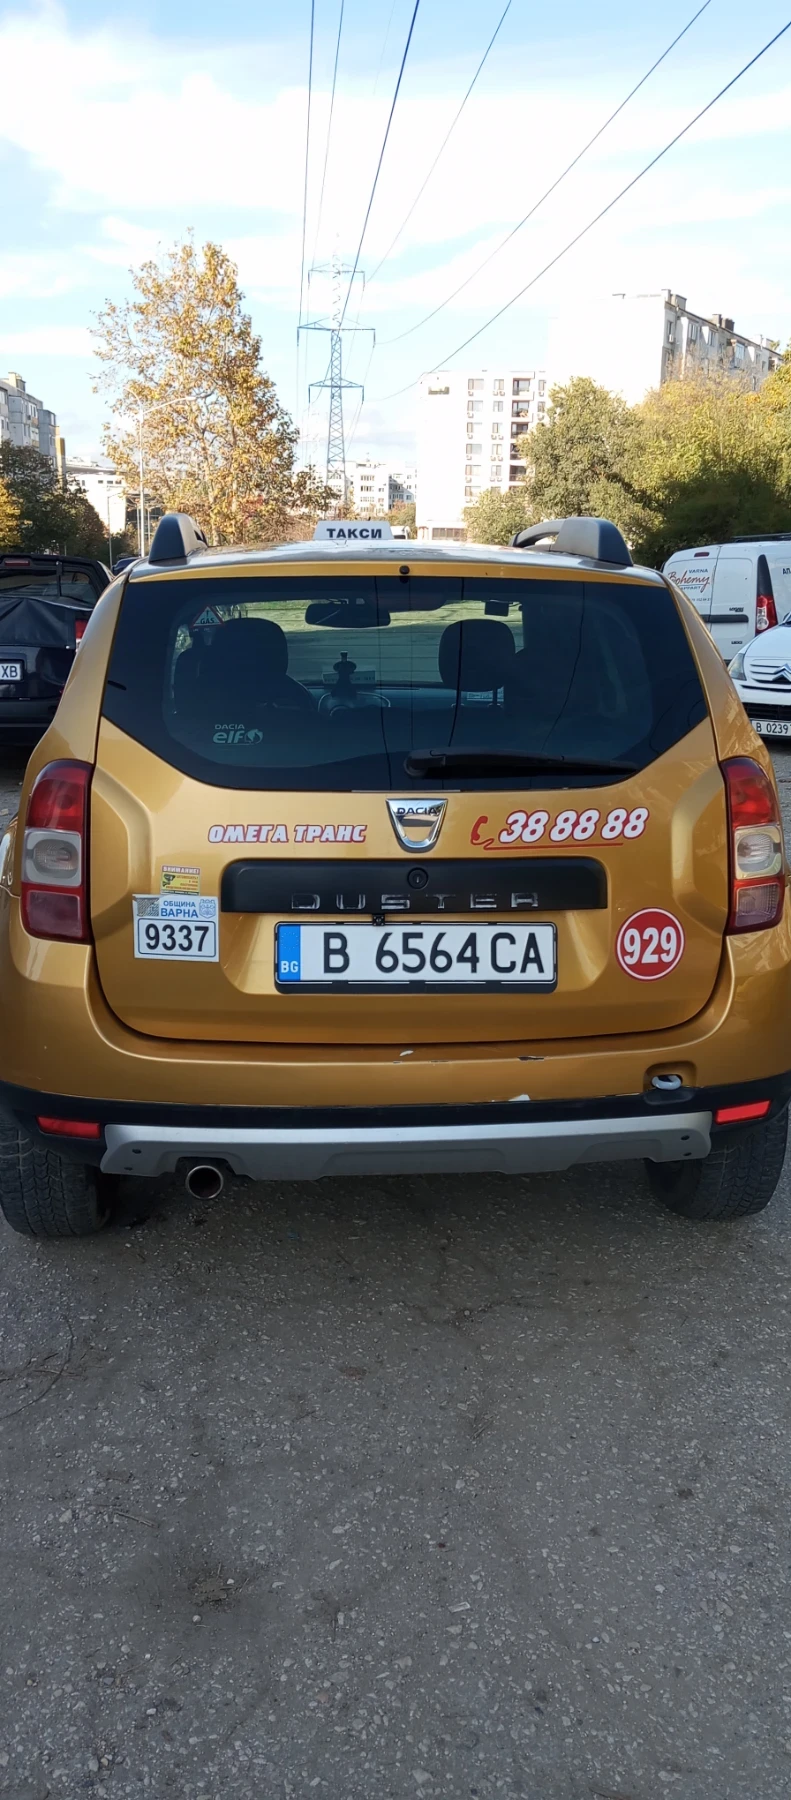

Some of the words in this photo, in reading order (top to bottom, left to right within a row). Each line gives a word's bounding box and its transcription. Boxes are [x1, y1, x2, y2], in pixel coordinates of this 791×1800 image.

[326, 527, 382, 539] ТАКСИ
[668, 570, 710, 593] Bohemy
[212, 730, 245, 743] elf
[396, 807, 437, 815] DACIA
[208, 824, 289, 843] ОМЕГА
[294, 824, 367, 843] ТРАНС
[499, 810, 550, 843] 38
[549, 809, 600, 842] 88
[600, 807, 649, 840] 88
[163, 900, 196, 908] ОБЩИНА
[291, 892, 539, 910] DUSTER
[160, 907, 199, 918] ВАРНА
[145, 923, 209, 952] 9337
[623, 926, 677, 965] 929
[375, 932, 480, 974] 6564
[280, 961, 299, 973] BG
